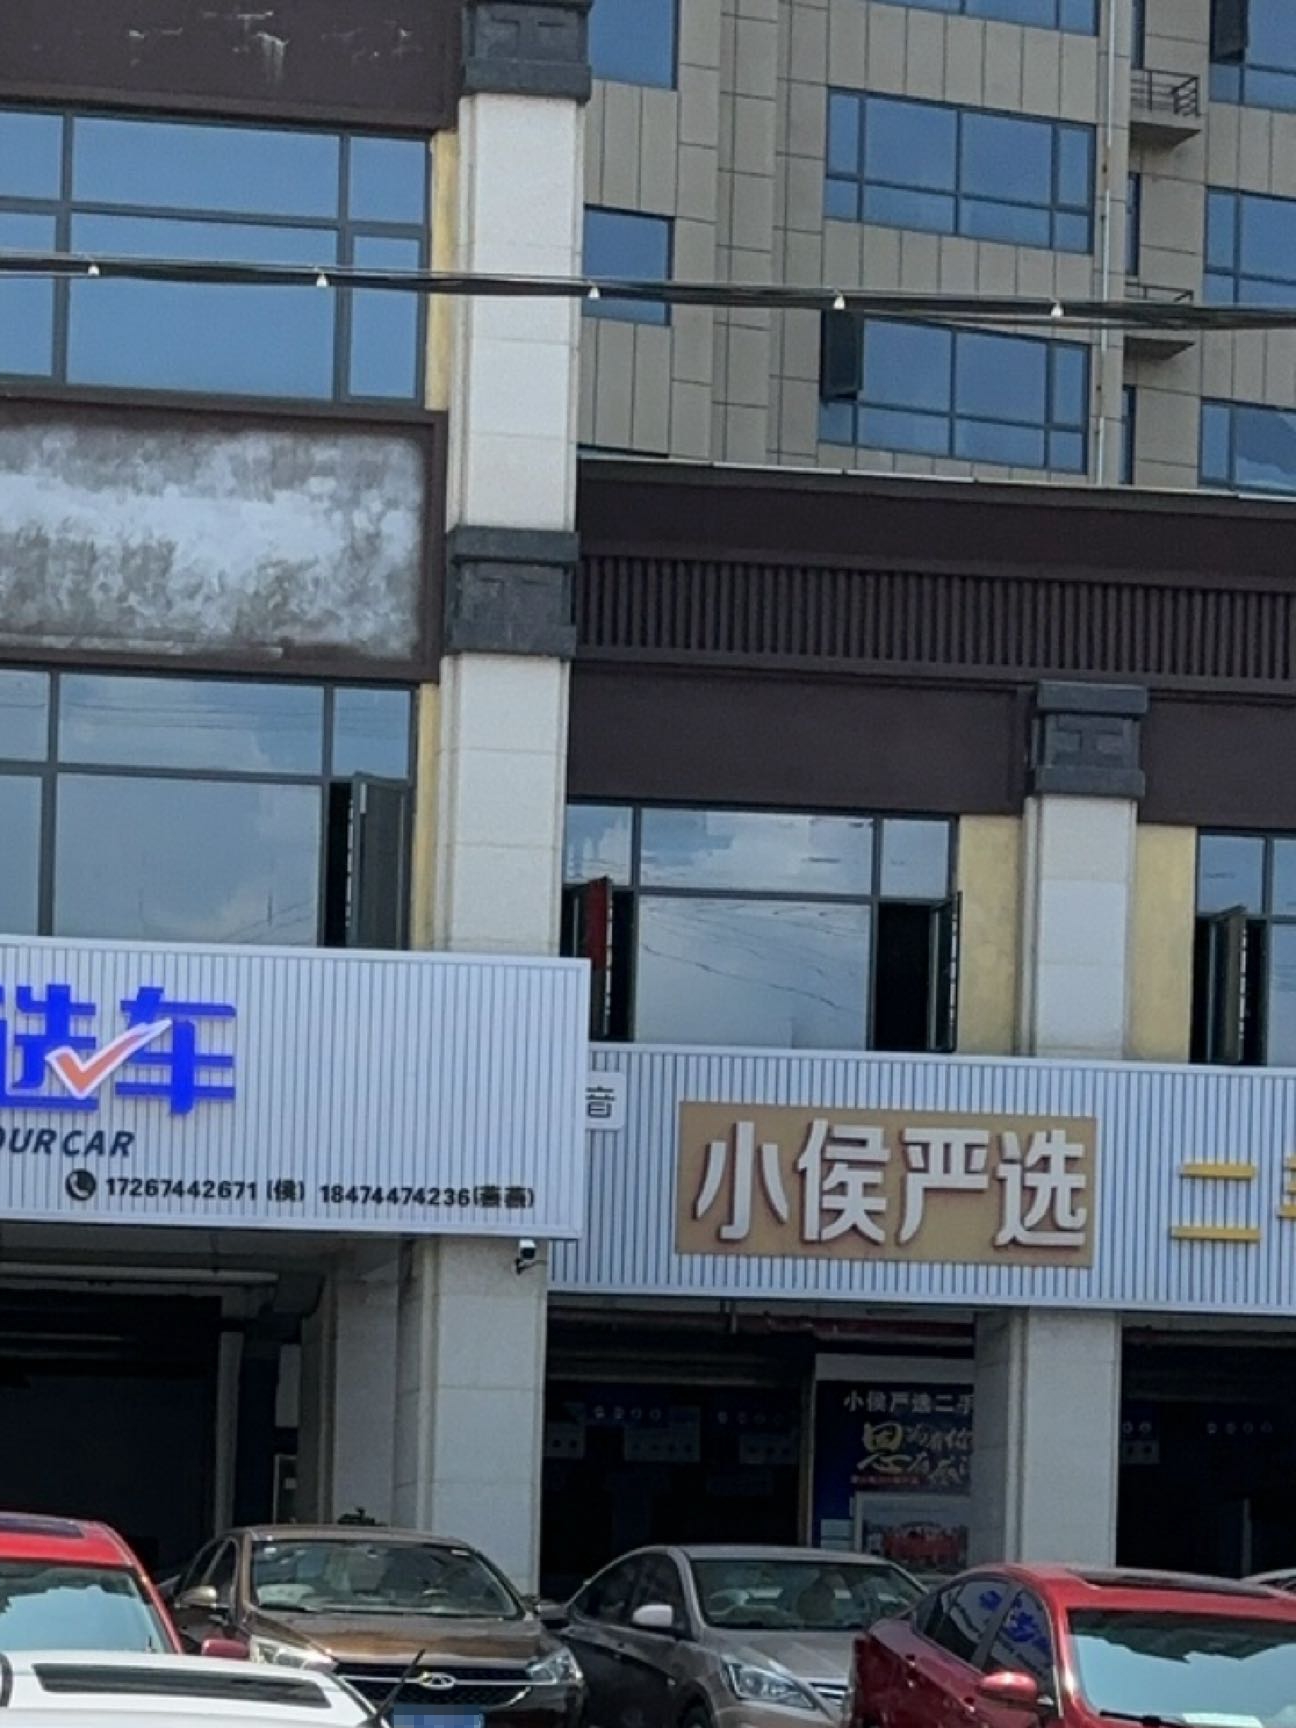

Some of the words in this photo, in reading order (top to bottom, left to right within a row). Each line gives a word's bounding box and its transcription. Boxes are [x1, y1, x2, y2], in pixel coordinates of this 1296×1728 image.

[105, 1177, 257, 1201] 17267442671
[692, 1117, 1088, 1249] 小侯严选
[1168, 1152, 1296, 1243] 二
